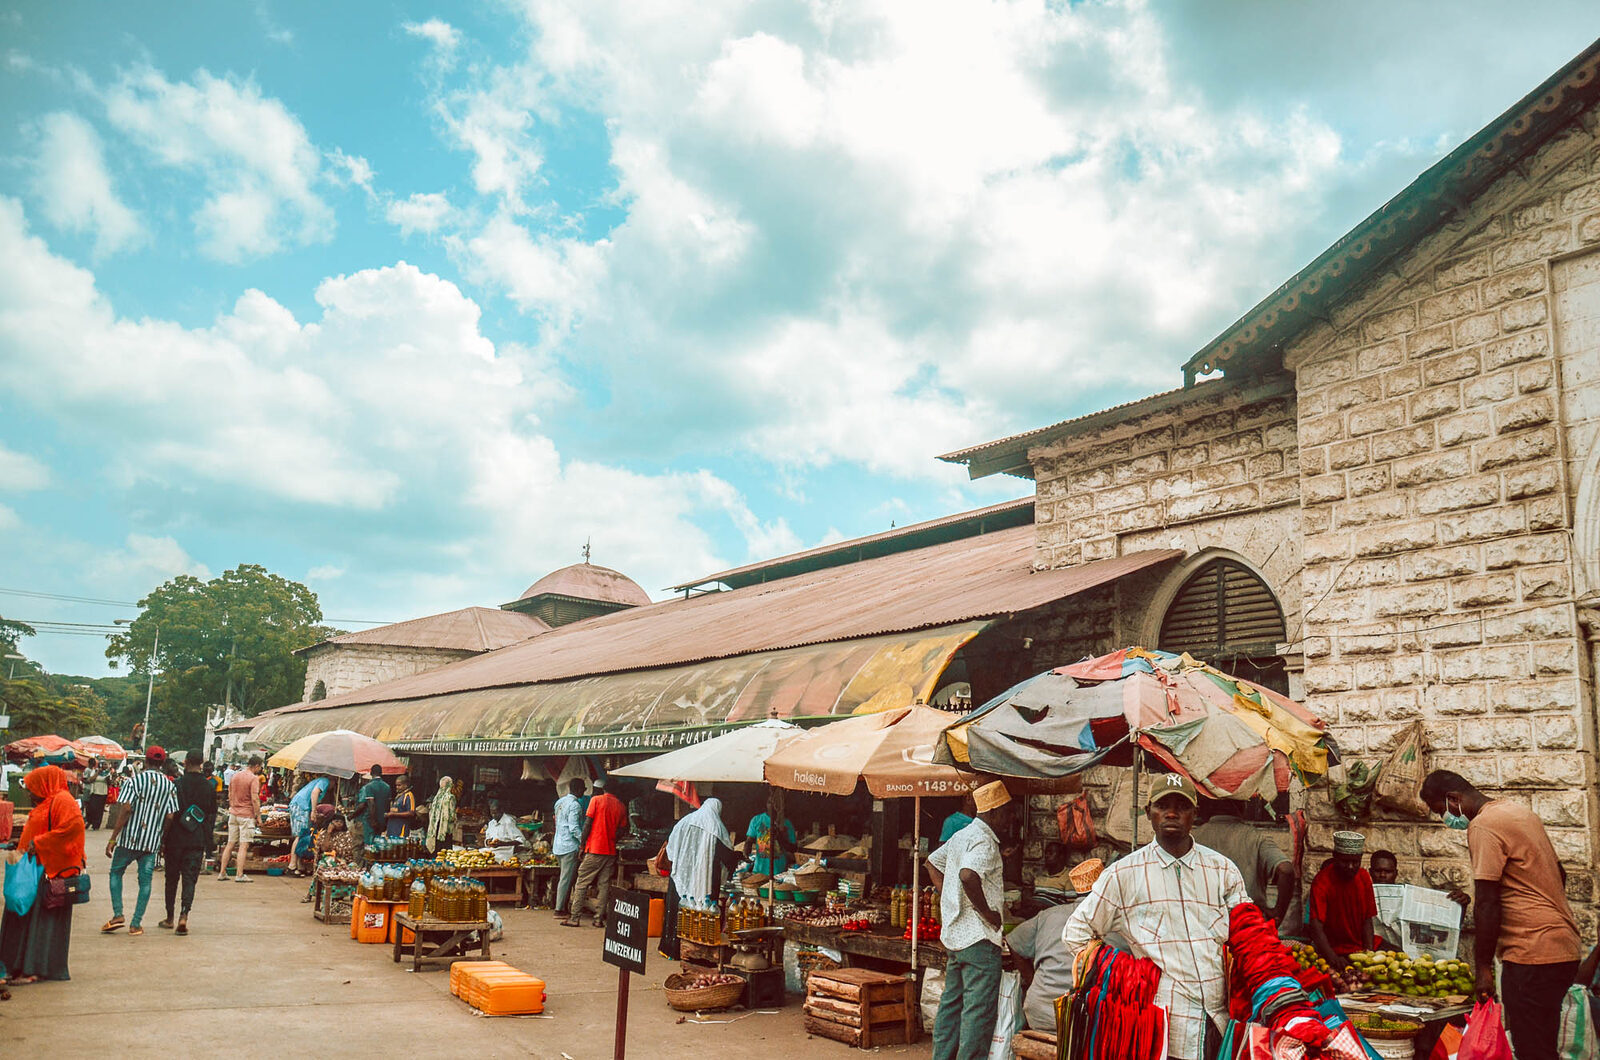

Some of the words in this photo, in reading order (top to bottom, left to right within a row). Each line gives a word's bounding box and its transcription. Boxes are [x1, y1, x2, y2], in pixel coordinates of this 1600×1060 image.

[574, 738, 609, 750] KWENDA
[613, 736, 641, 748] 15670
[886, 783, 914, 791] BANDO
[1166, 773, 1182, 787] NY
[614, 899, 640, 919] ZANZIBAR
[616, 920, 631, 938] SAFI
